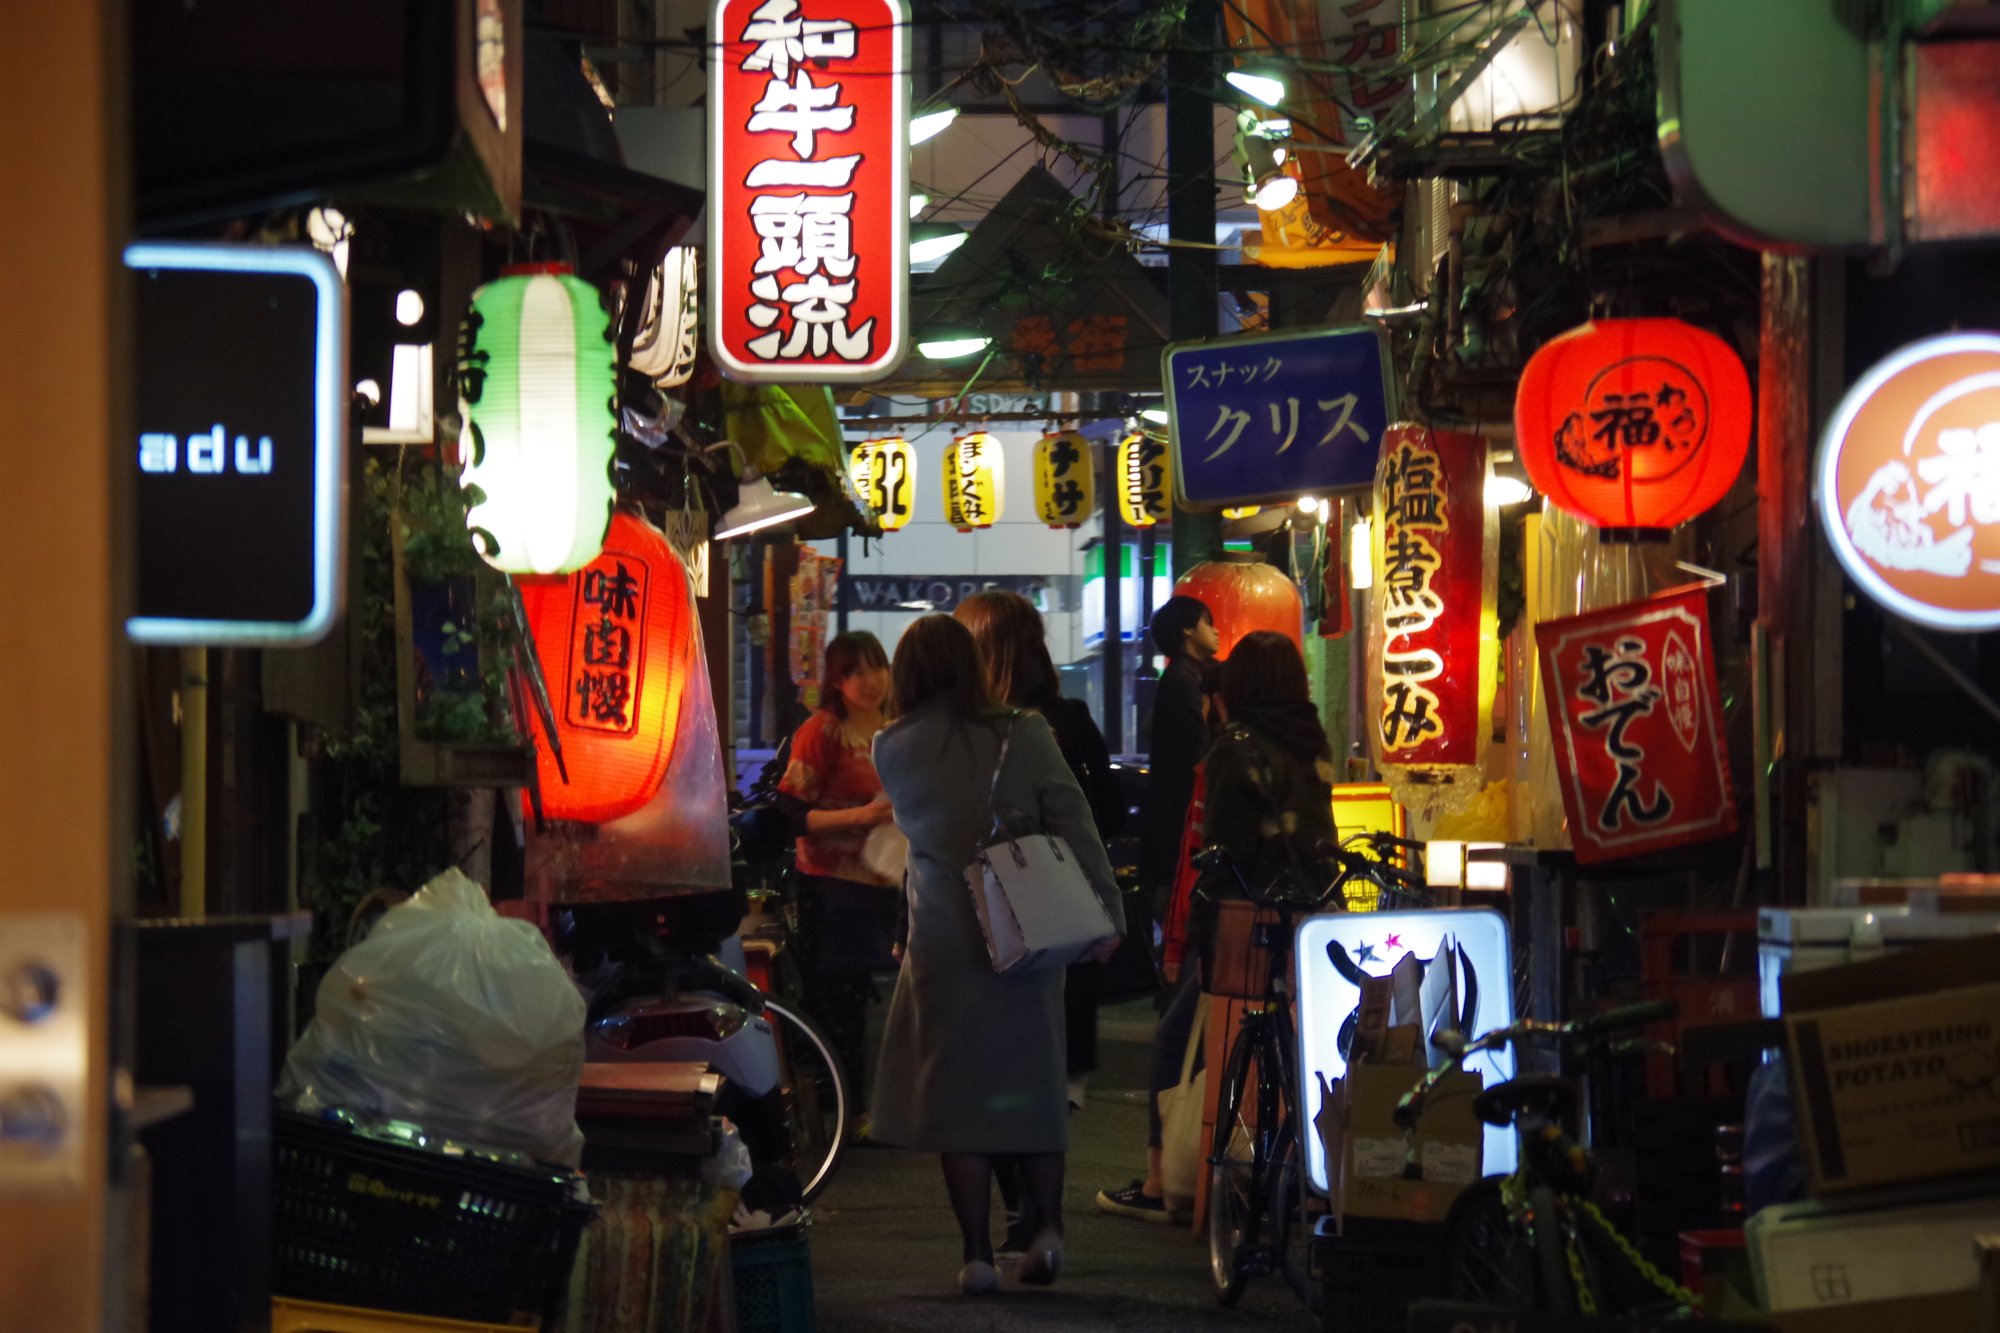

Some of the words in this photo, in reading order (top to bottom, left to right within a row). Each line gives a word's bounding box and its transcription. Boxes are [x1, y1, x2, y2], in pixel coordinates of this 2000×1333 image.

[741, 0, 876, 361] 和牛一頭流
[1186, 356, 1283, 390] スナック
[1202, 391, 1371, 464] クリス
[1589, 392, 1661, 451] 福
[854, 581, 999, 605] WAKOR
[1577, 636, 1673, 829] おでん
[1828, 1020, 1991, 1061] SHOESTRING
[1835, 1056, 1945, 1089] POTATO
